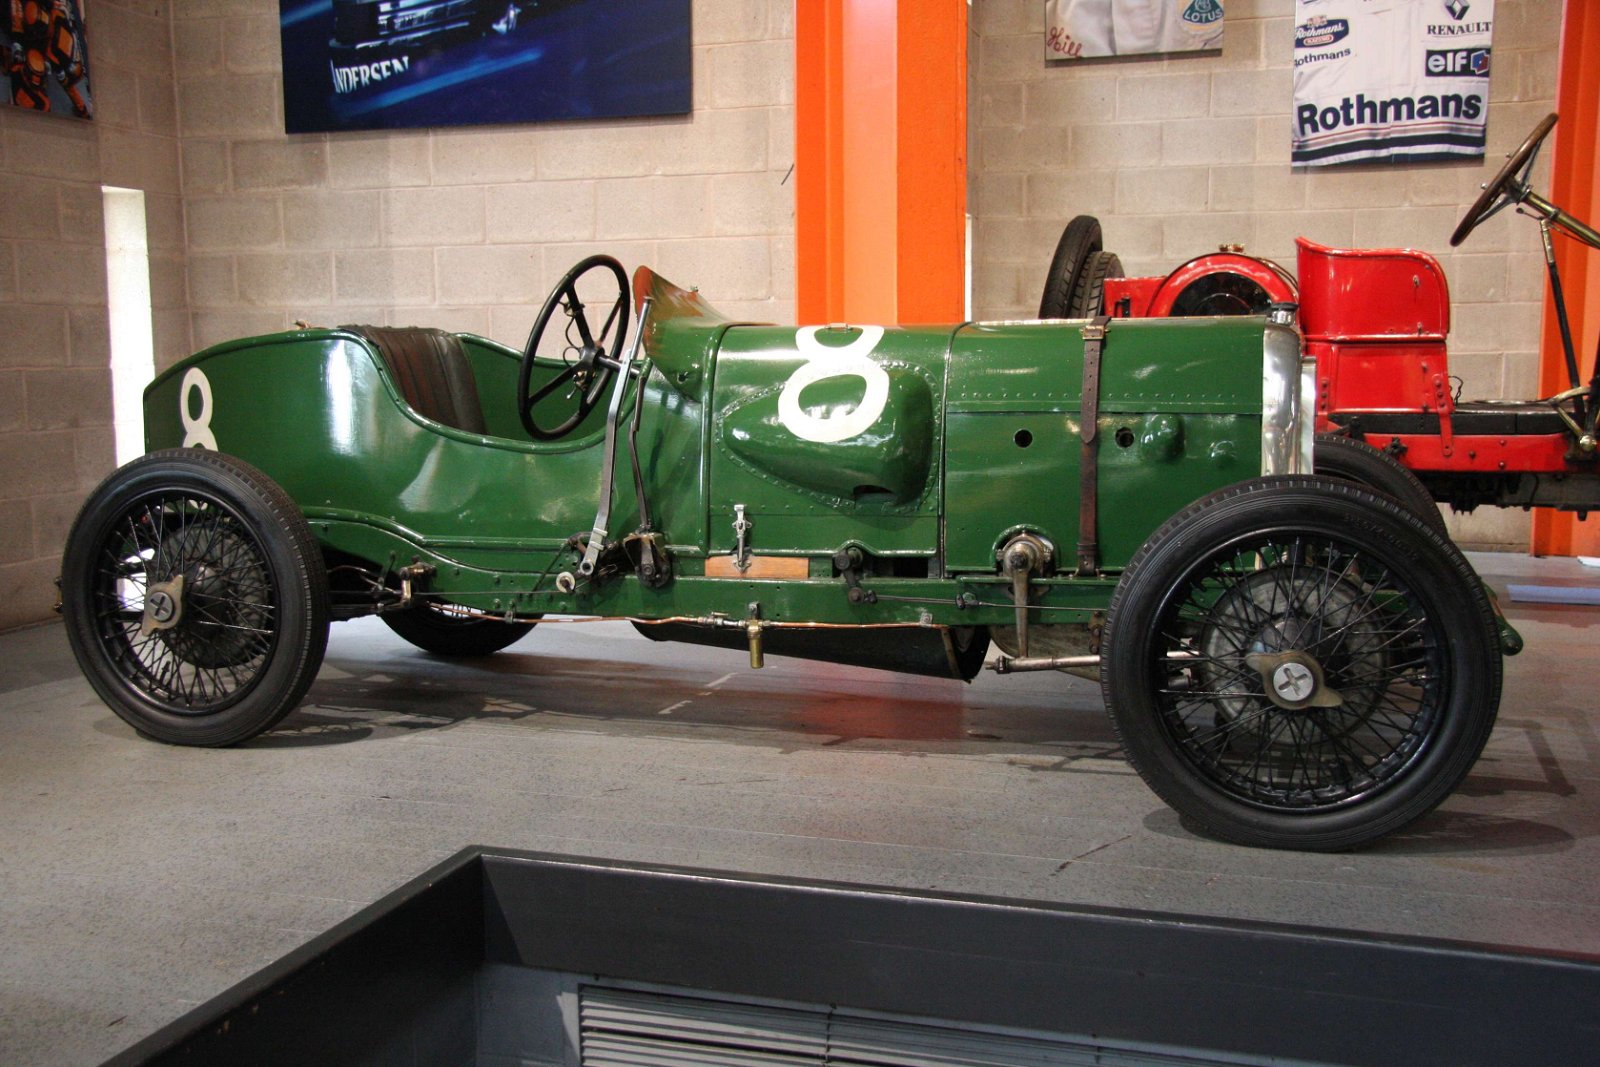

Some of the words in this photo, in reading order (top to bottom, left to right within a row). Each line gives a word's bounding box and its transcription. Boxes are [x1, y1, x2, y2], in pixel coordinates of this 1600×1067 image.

[1184, 9, 1223, 23] LOTUS
[1427, 21, 1492, 36] RENAULT
[1047, 26, 1082, 57] Hill
[1428, 51, 1467, 73] elf
[1297, 93, 1482, 137] Rothmans
[778, 325, 889, 443] 8
